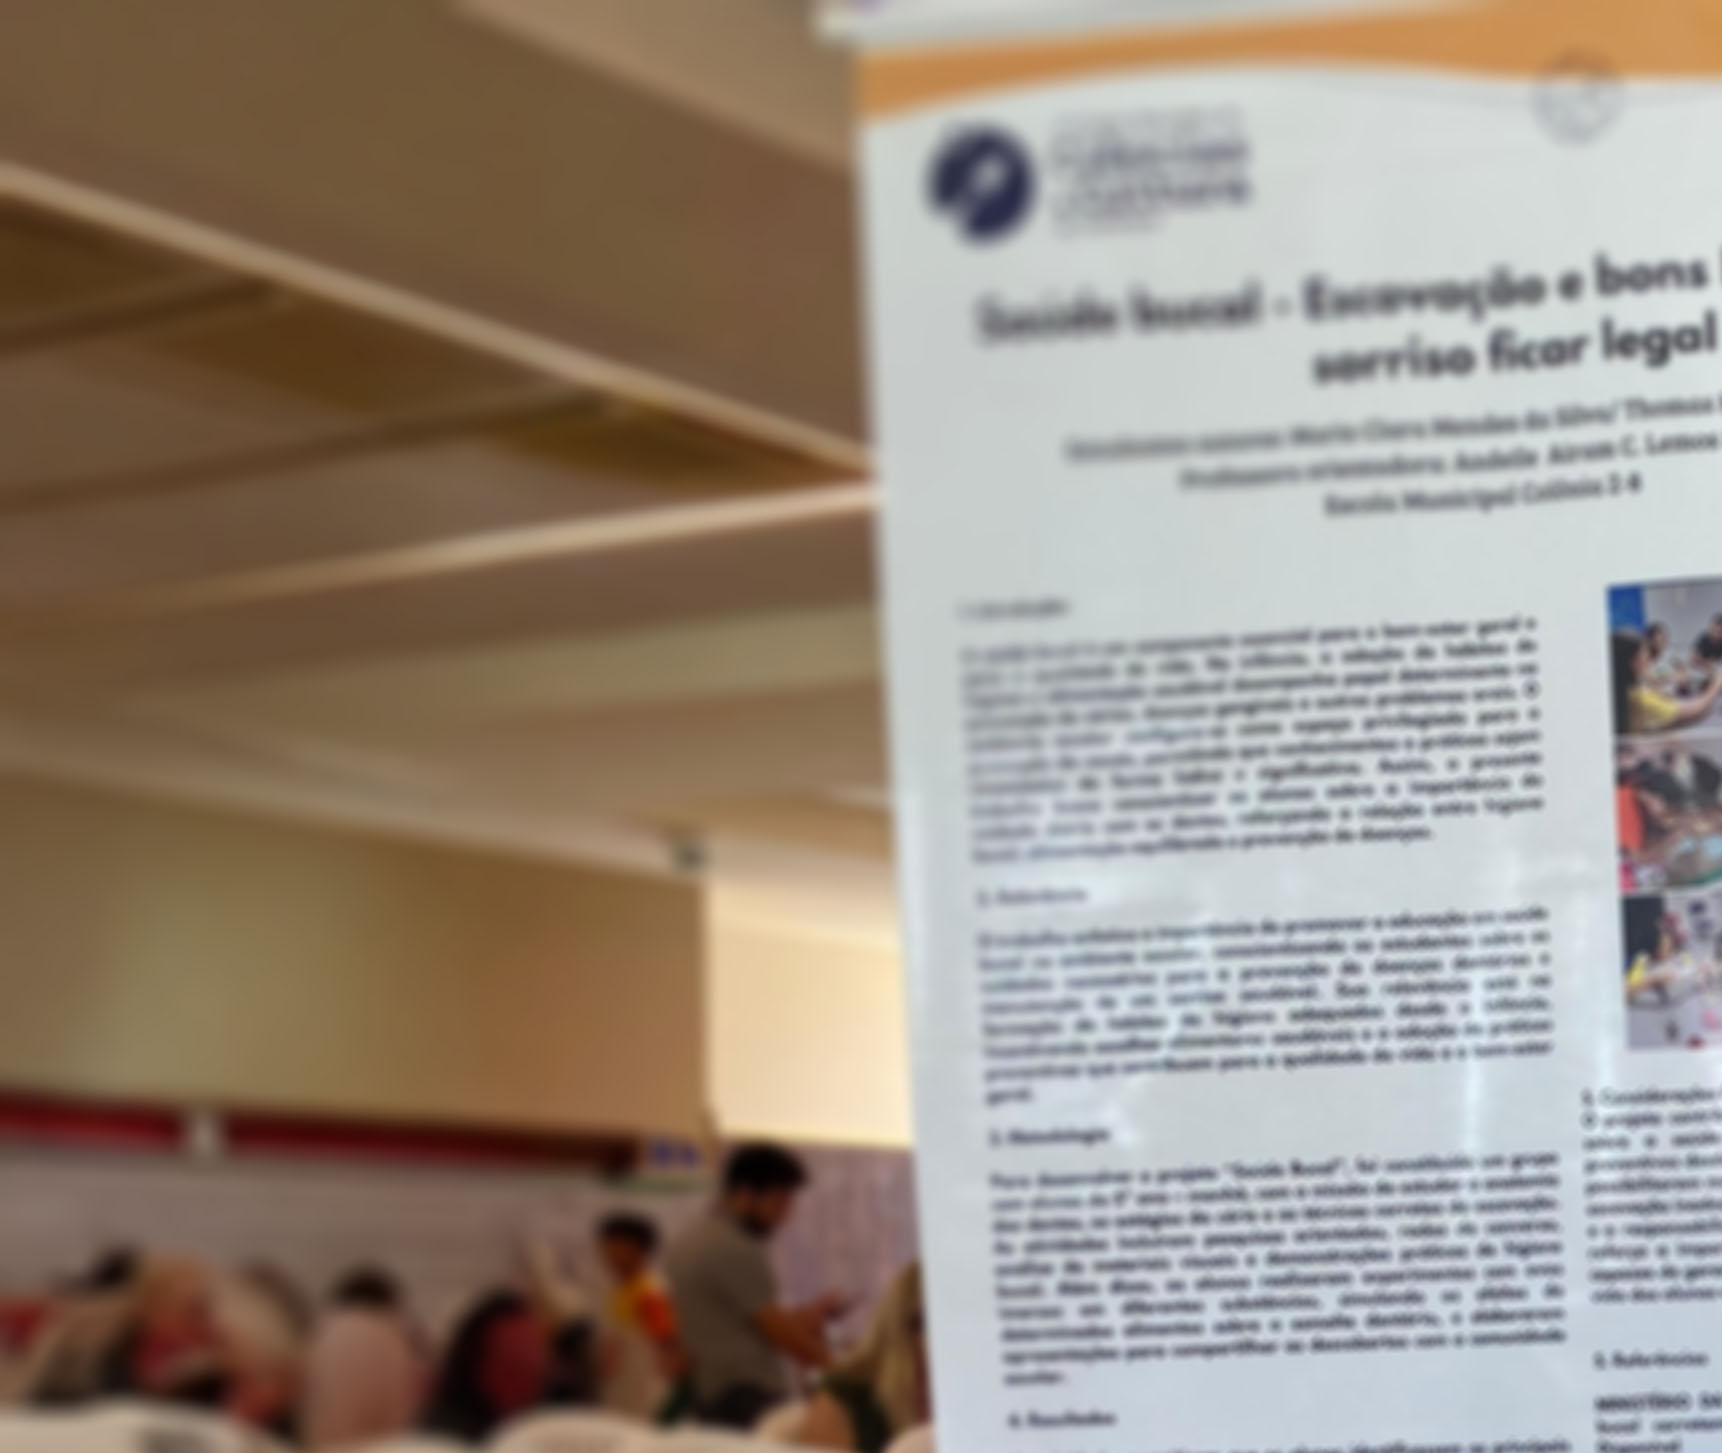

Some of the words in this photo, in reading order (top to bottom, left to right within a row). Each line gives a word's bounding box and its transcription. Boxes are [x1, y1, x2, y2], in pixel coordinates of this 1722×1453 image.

[1305, 264, 1547, 322] Escavação
[1558, 269, 1585, 302] e
[1596, 251, 1709, 297] bons
[1314, 333, 1476, 387] sorriso
[1487, 327, 1591, 373] ficar
[1601, 309, 1718, 370] legal
